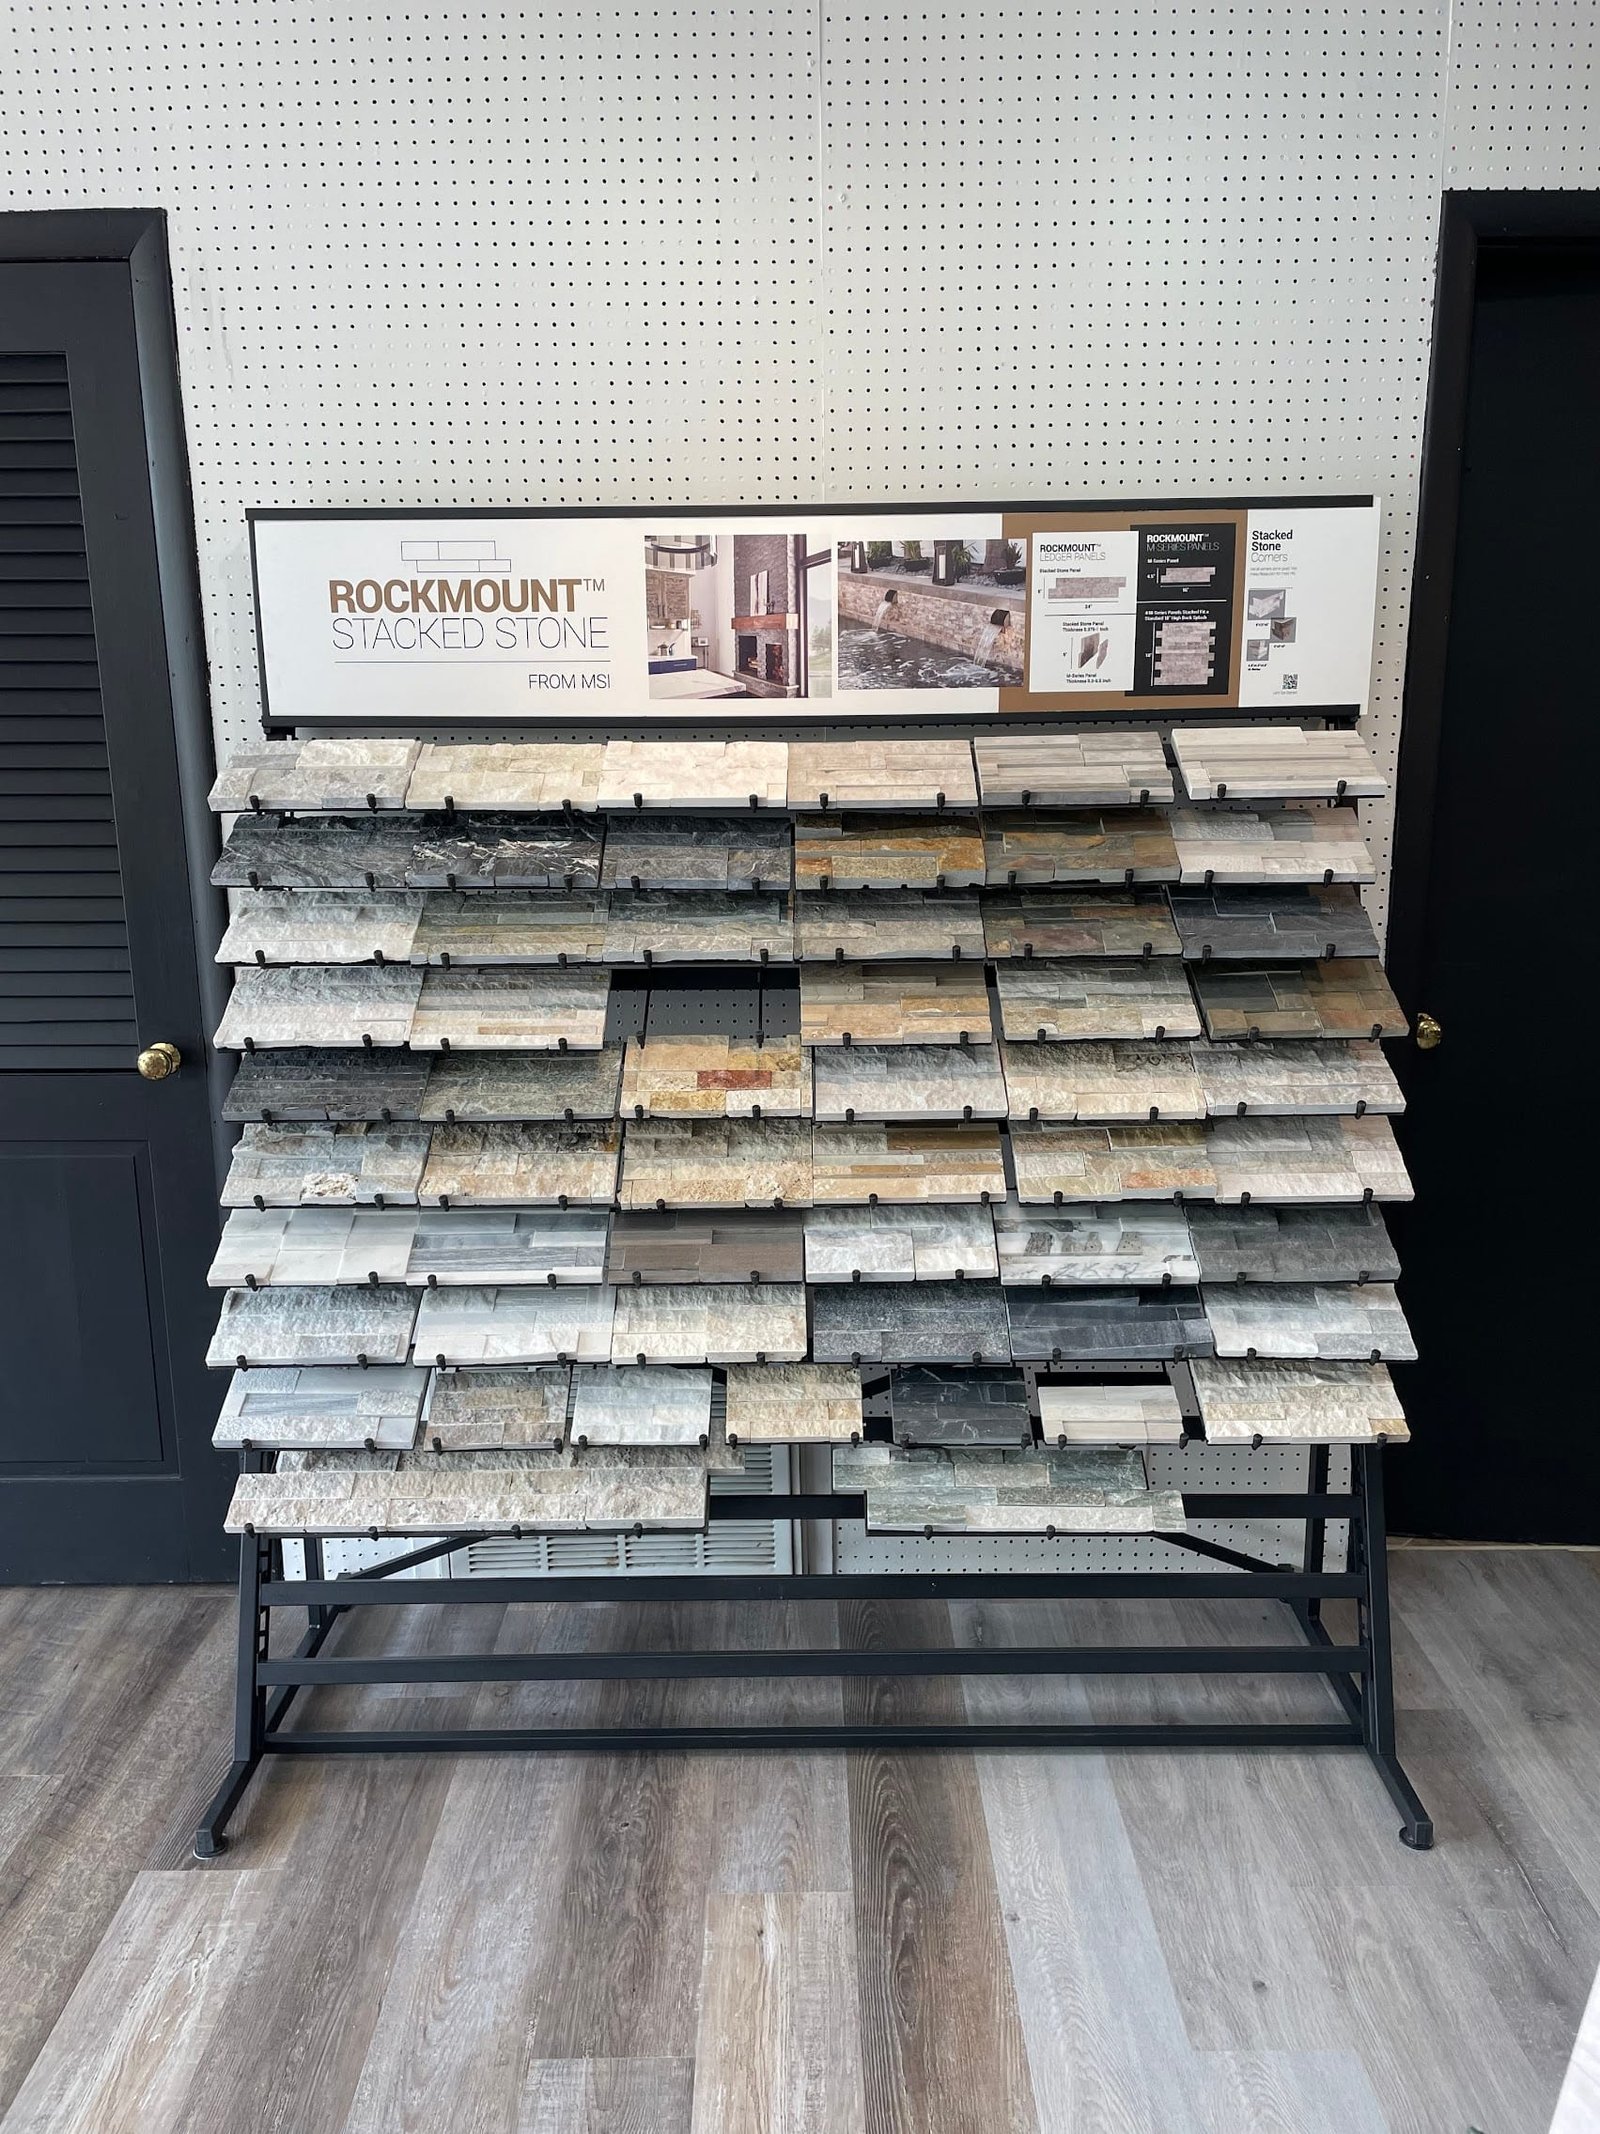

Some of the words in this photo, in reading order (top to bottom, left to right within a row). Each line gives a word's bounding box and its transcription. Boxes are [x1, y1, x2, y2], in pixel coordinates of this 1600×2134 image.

[1251, 529, 1293, 541] Stacked
[1187, 542, 1220, 551] PANELS
[1251, 541, 1282, 551] Stone
[1040, 552, 1072, 562] LEDGER
[1074, 552, 1106, 561] PANELS
[1251, 552, 1288, 562] Corners
[332, 617, 485, 650] STACKED
[495, 616, 610, 650] STONE
[528, 674, 576, 690] FROM
[580, 673, 611, 689] MSI
